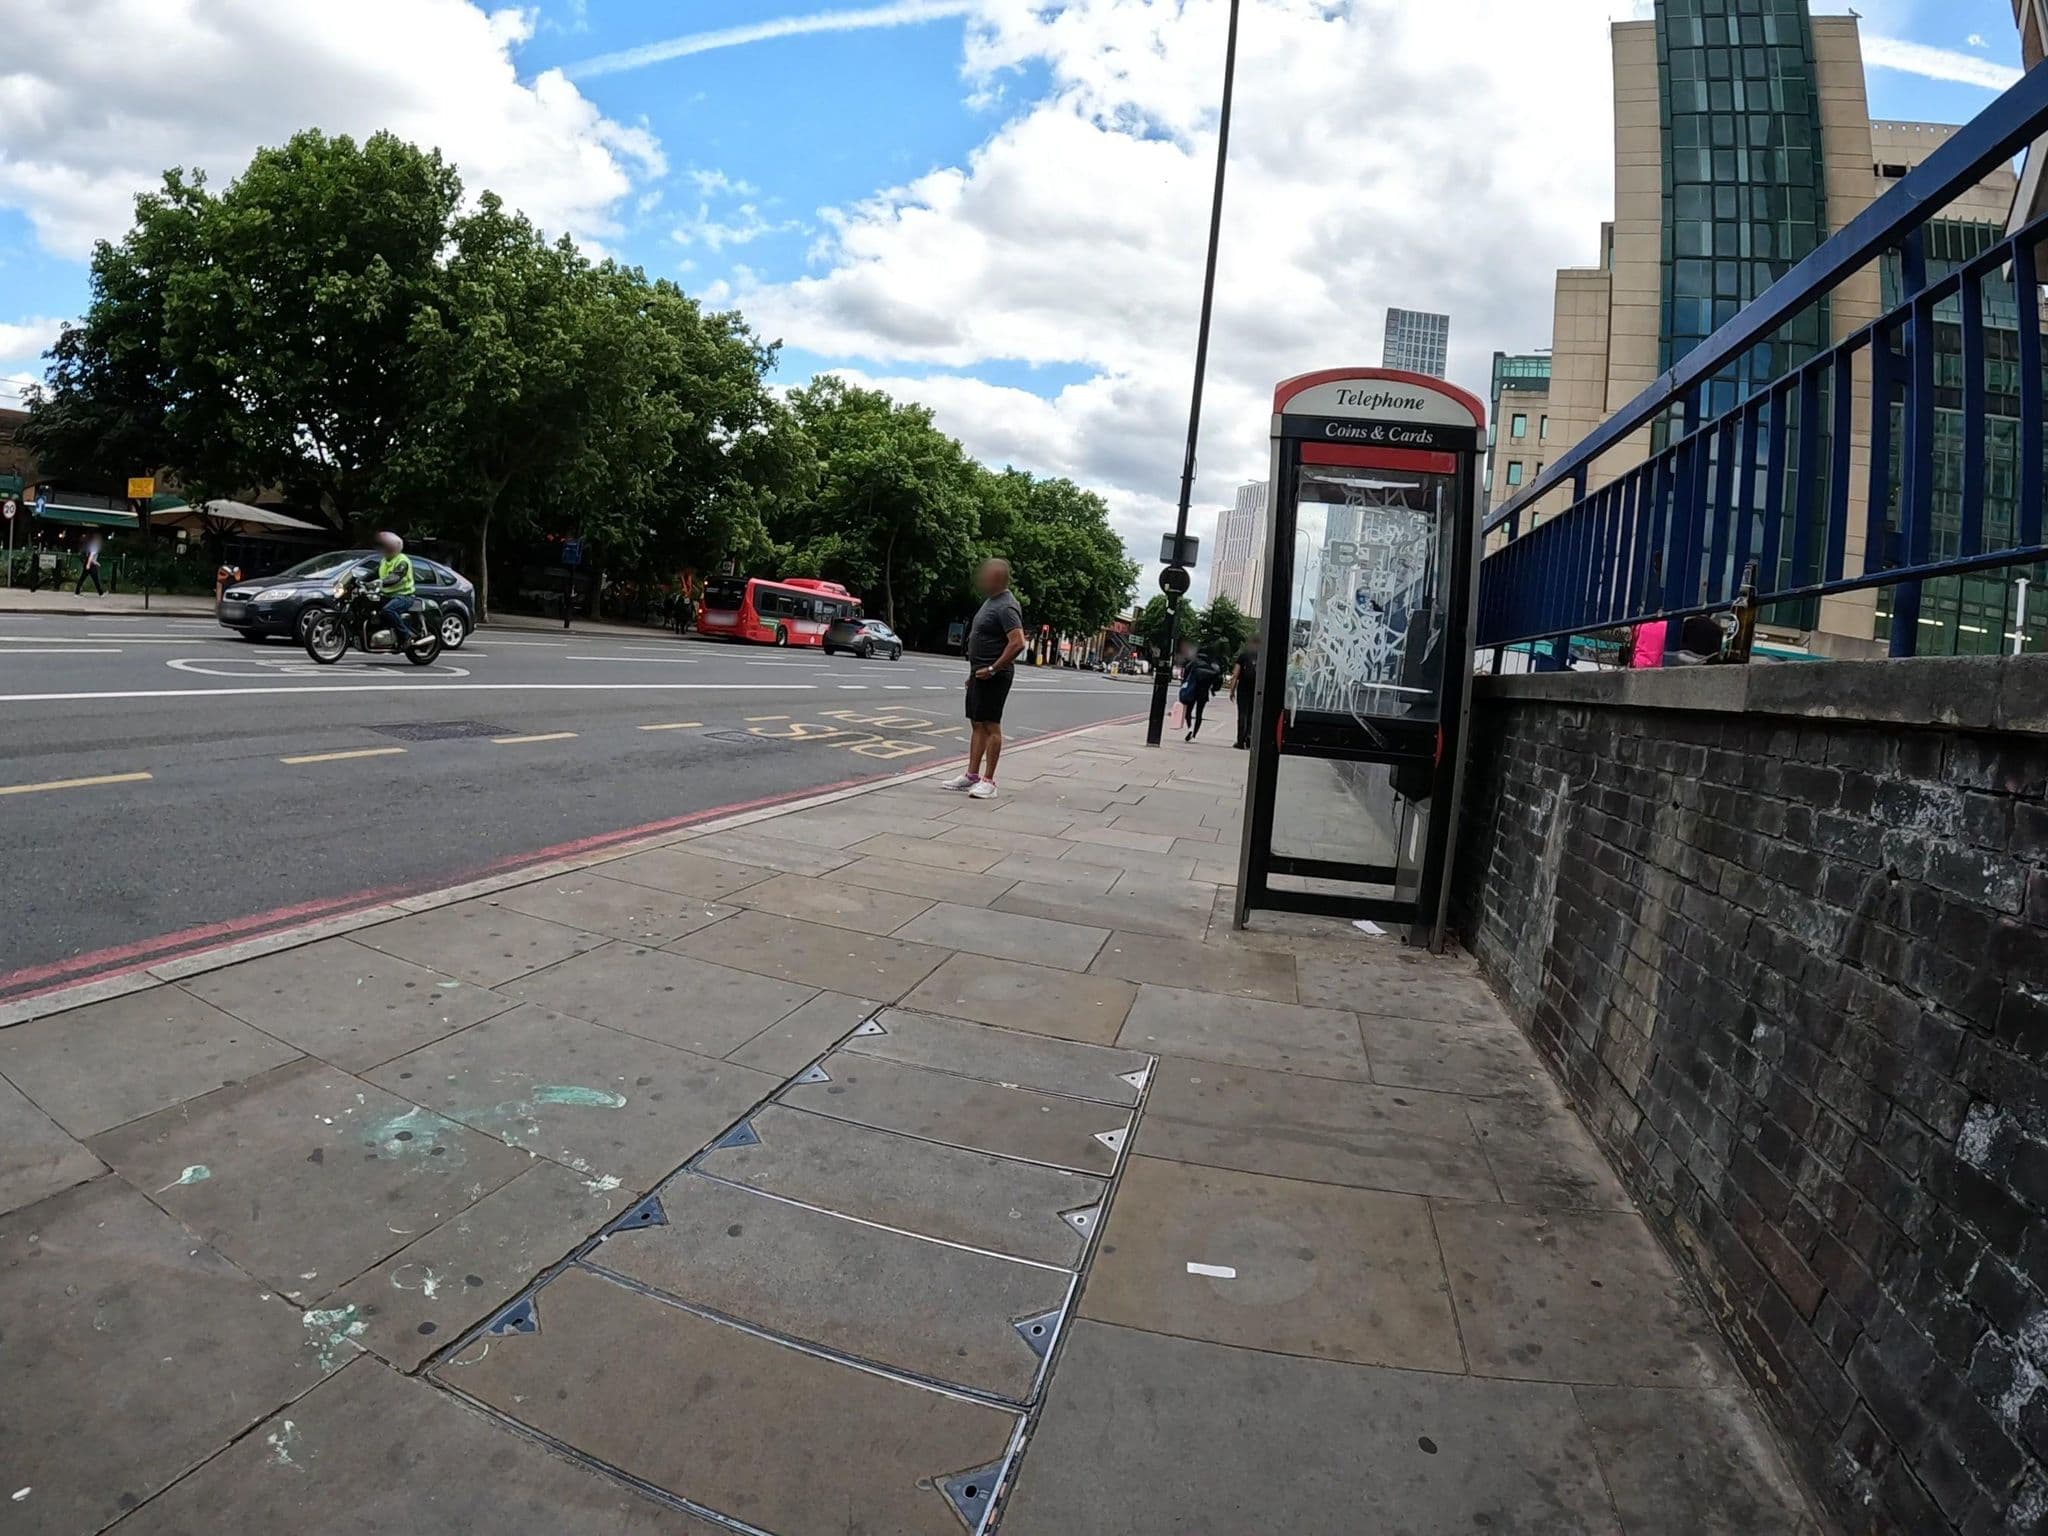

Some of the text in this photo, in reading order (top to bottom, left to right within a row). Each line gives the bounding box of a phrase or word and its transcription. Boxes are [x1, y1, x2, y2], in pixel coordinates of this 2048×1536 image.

[1336, 388, 1426, 411] Telephone
[1324, 422, 1434, 444] Coins & Cards
[748, 723, 937, 759] BUS
